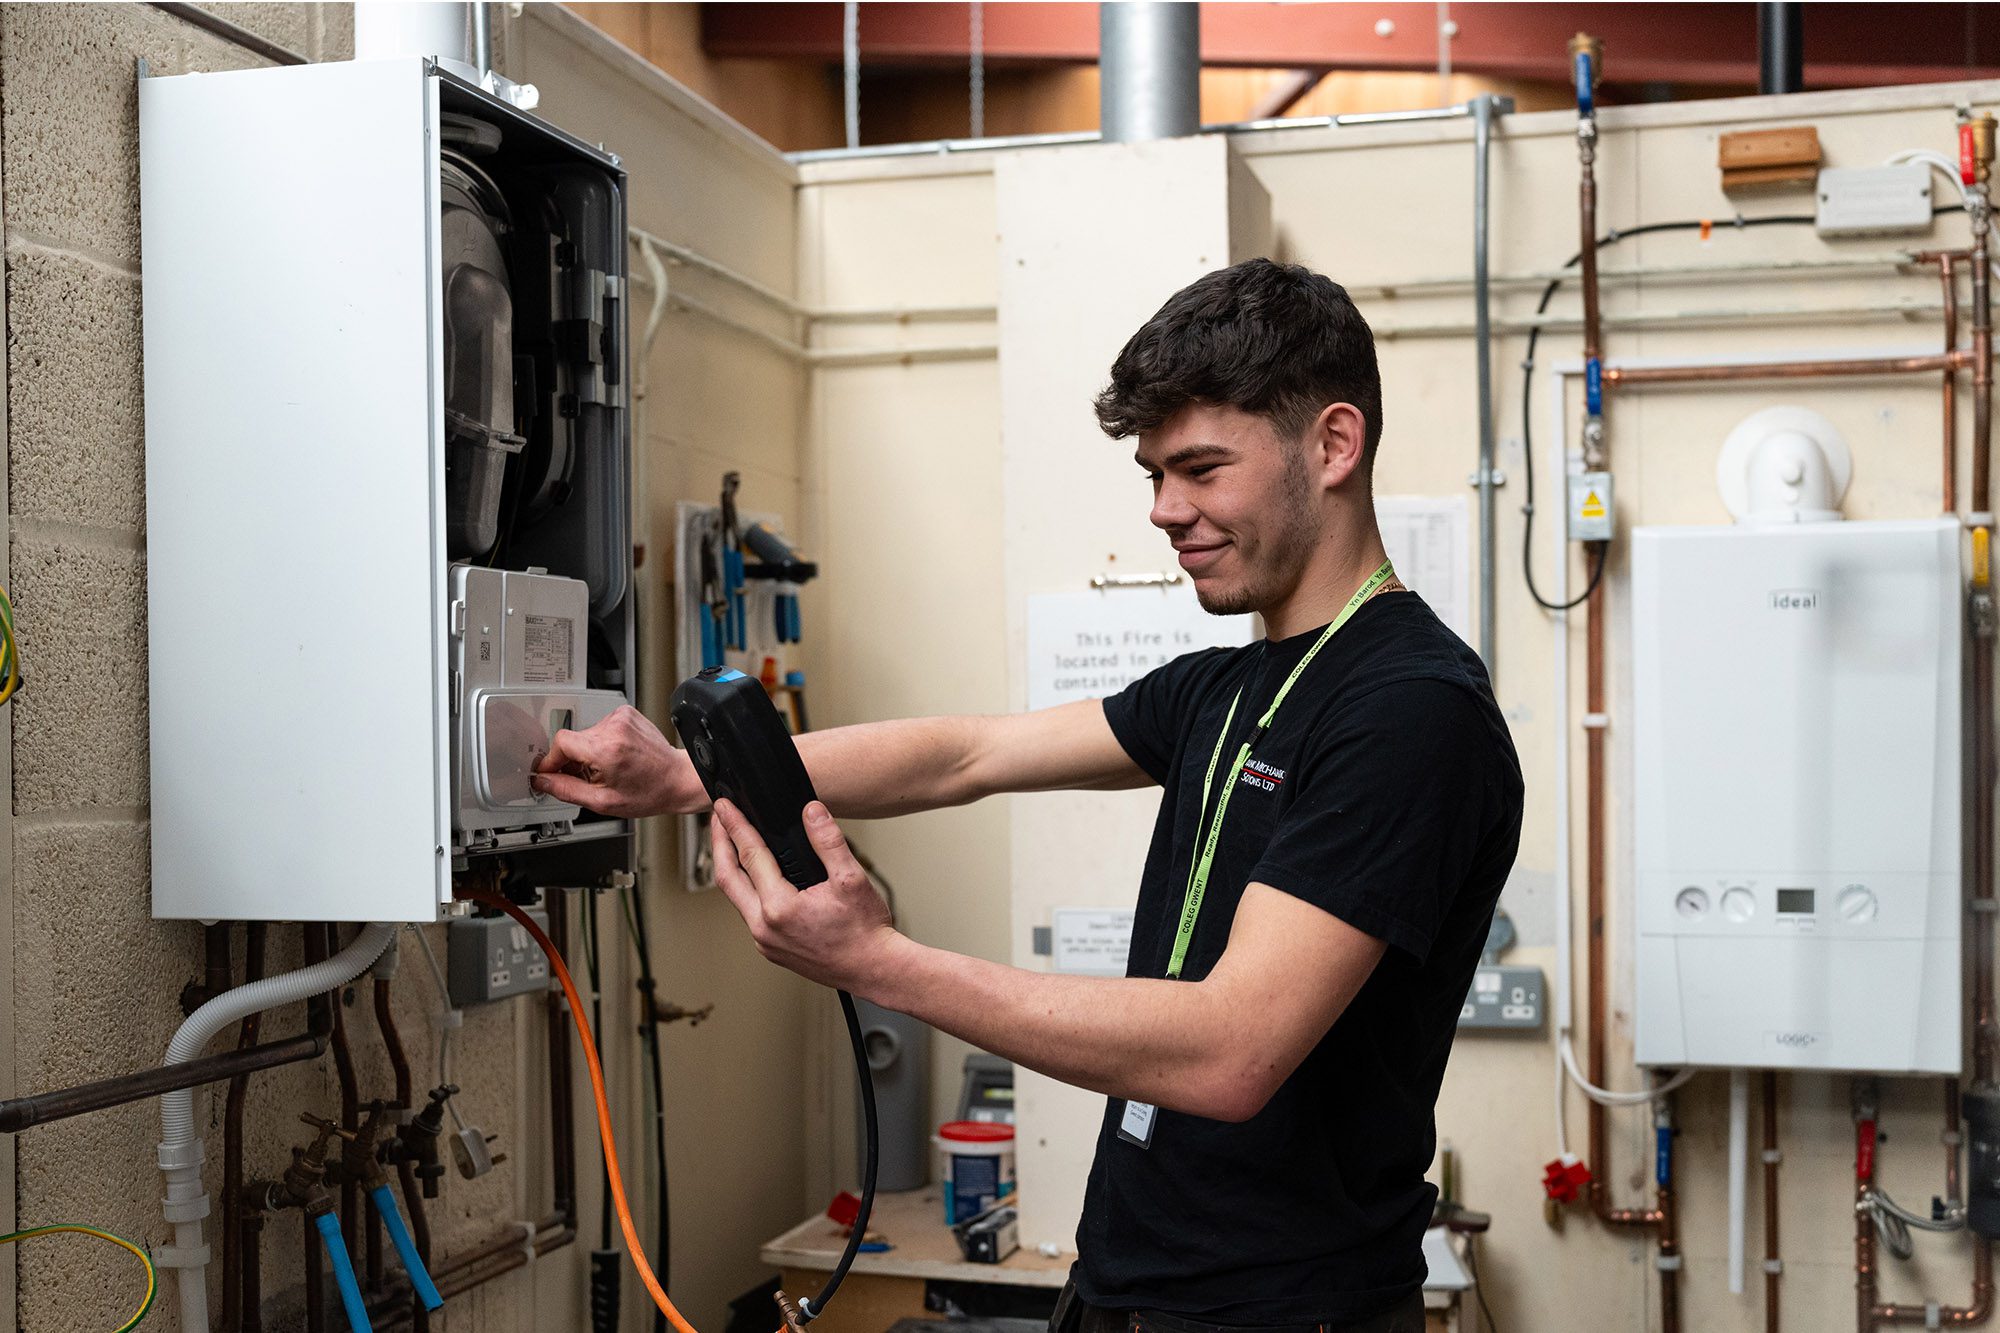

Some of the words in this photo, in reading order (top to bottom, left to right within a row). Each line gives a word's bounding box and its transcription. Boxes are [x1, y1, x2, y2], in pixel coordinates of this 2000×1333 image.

[1076, 631, 1112, 646] This
[1122, 630, 1162, 645] Fire
[1174, 629, 1192, 644] is
[1055, 653, 1119, 669] located
[1130, 652, 1148, 666] in
[1182, 907, 1196, 934] COLEG
[1190, 878, 1204, 907] GWENT
